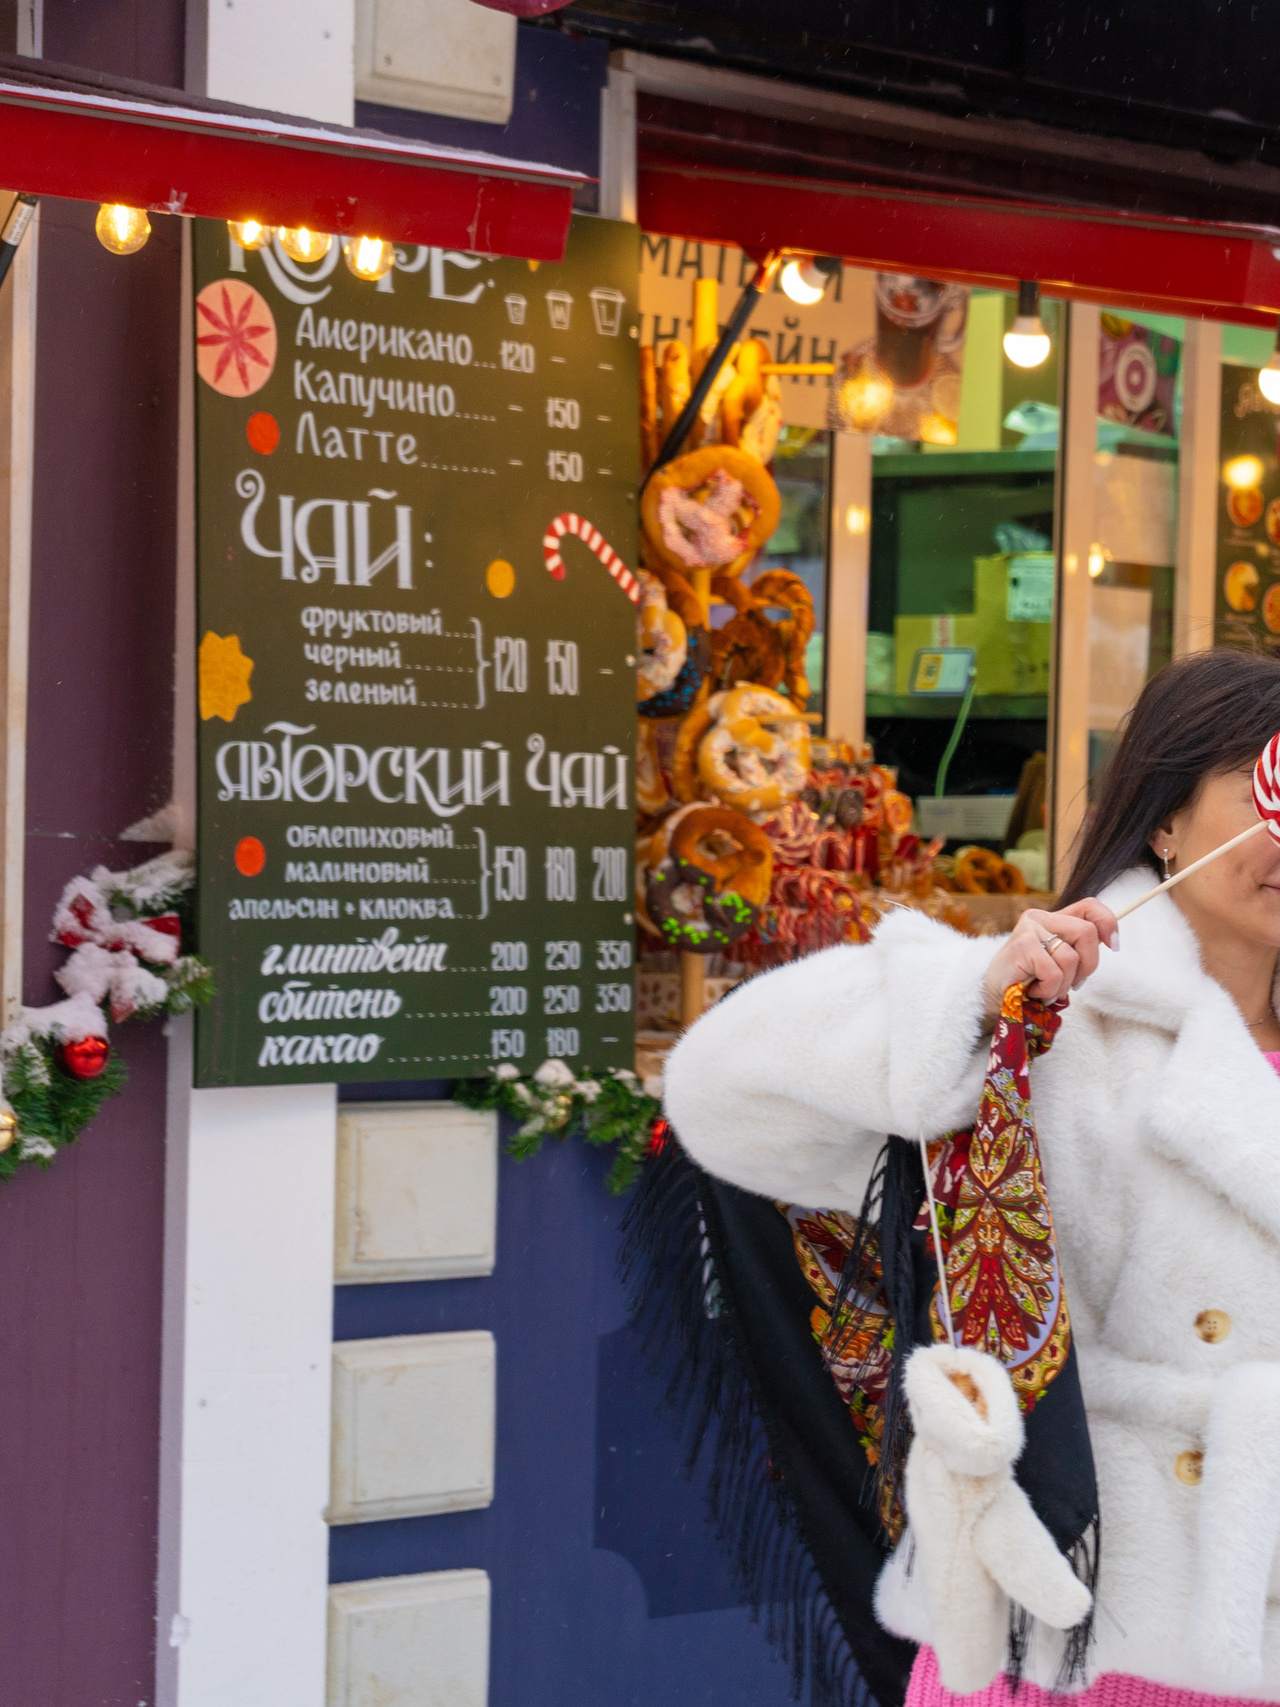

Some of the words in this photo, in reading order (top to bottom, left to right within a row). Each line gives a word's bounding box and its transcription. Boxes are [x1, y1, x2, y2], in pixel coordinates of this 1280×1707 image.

[296, 307, 472, 366] Американо
[500, 341, 534, 373] 120
[294, 360, 456, 417] Капучино
[546, 397, 580, 429] 150
[296, 412, 418, 465] Латте
[547, 451, 583, 482] 150
[302, 606, 441, 638] фруктовый
[305, 641, 401, 673] черный
[494, 637, 528, 693] 120
[546, 640, 578, 696] 150
[305, 677, 417, 705] зеленый
[215, 721, 509, 817] АВТОРСКИЙ
[526, 733, 628, 810] ЧАЙ
[286, 823, 454, 849] облепиховый
[285, 857, 429, 884] малиновый
[494, 846, 526, 901] 150
[592, 846, 627, 901] 200
[228, 897, 339, 920] апельсин
[360, 897, 455, 920] клюква
[261, 927, 447, 976] глинтвейн
[491, 941, 528, 971] 200
[545, 940, 581, 971] 250
[596, 940, 632, 970] 350
[259, 980, 402, 1023] сбитень
[489, 986, 527, 1016] 200
[543, 985, 580, 1014] 250
[595, 983, 632, 1013] 350
[258, 1033, 384, 1067] какао
[491, 1029, 525, 1059] 150
